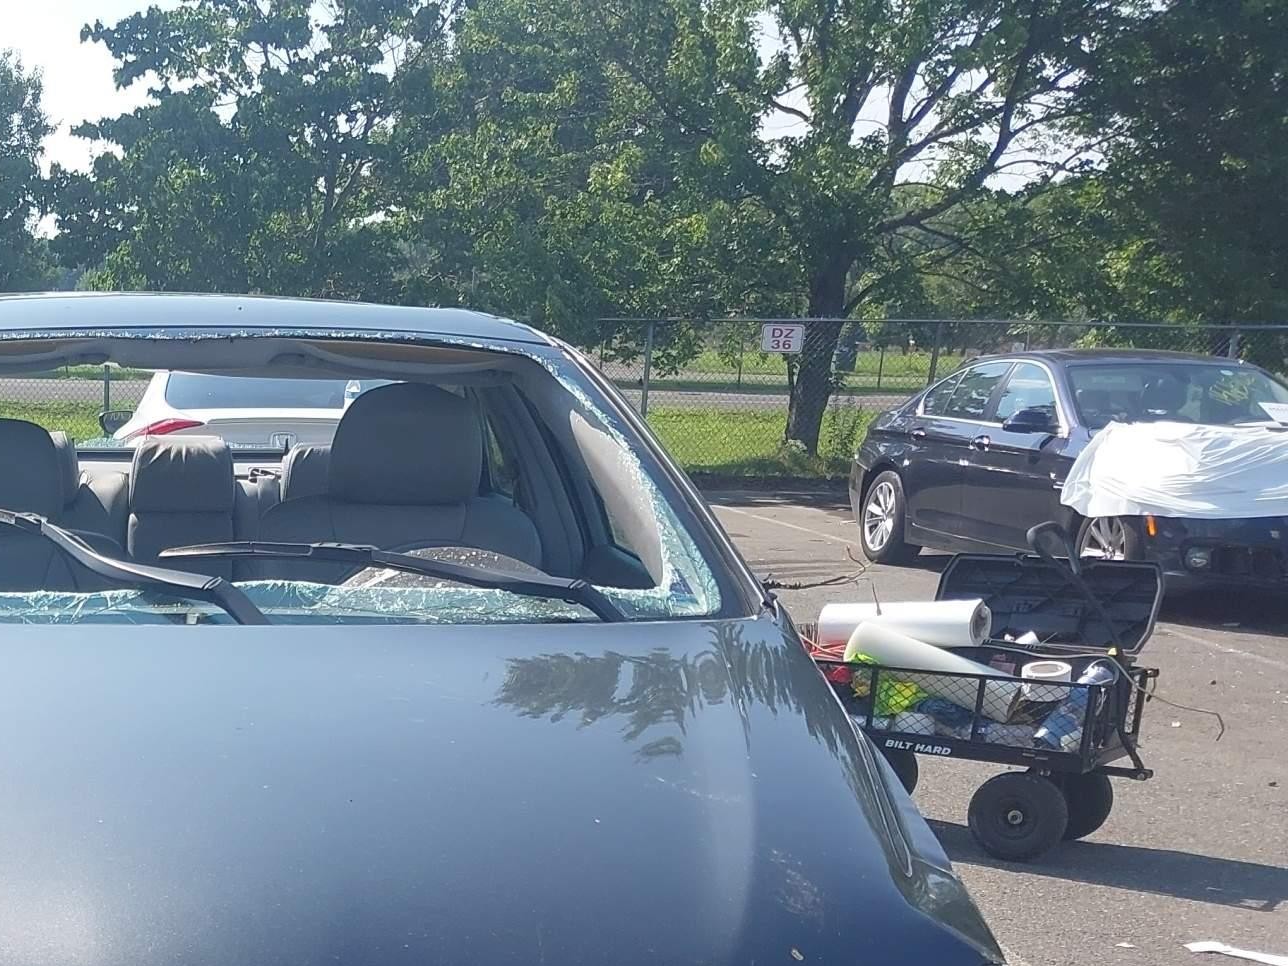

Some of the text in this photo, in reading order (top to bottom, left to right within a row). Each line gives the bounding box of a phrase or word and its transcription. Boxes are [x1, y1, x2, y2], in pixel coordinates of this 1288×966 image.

[772, 328, 795, 338] DZ
[771, 340, 791, 349] 36
[885, 739, 952, 755] BILT HARD
